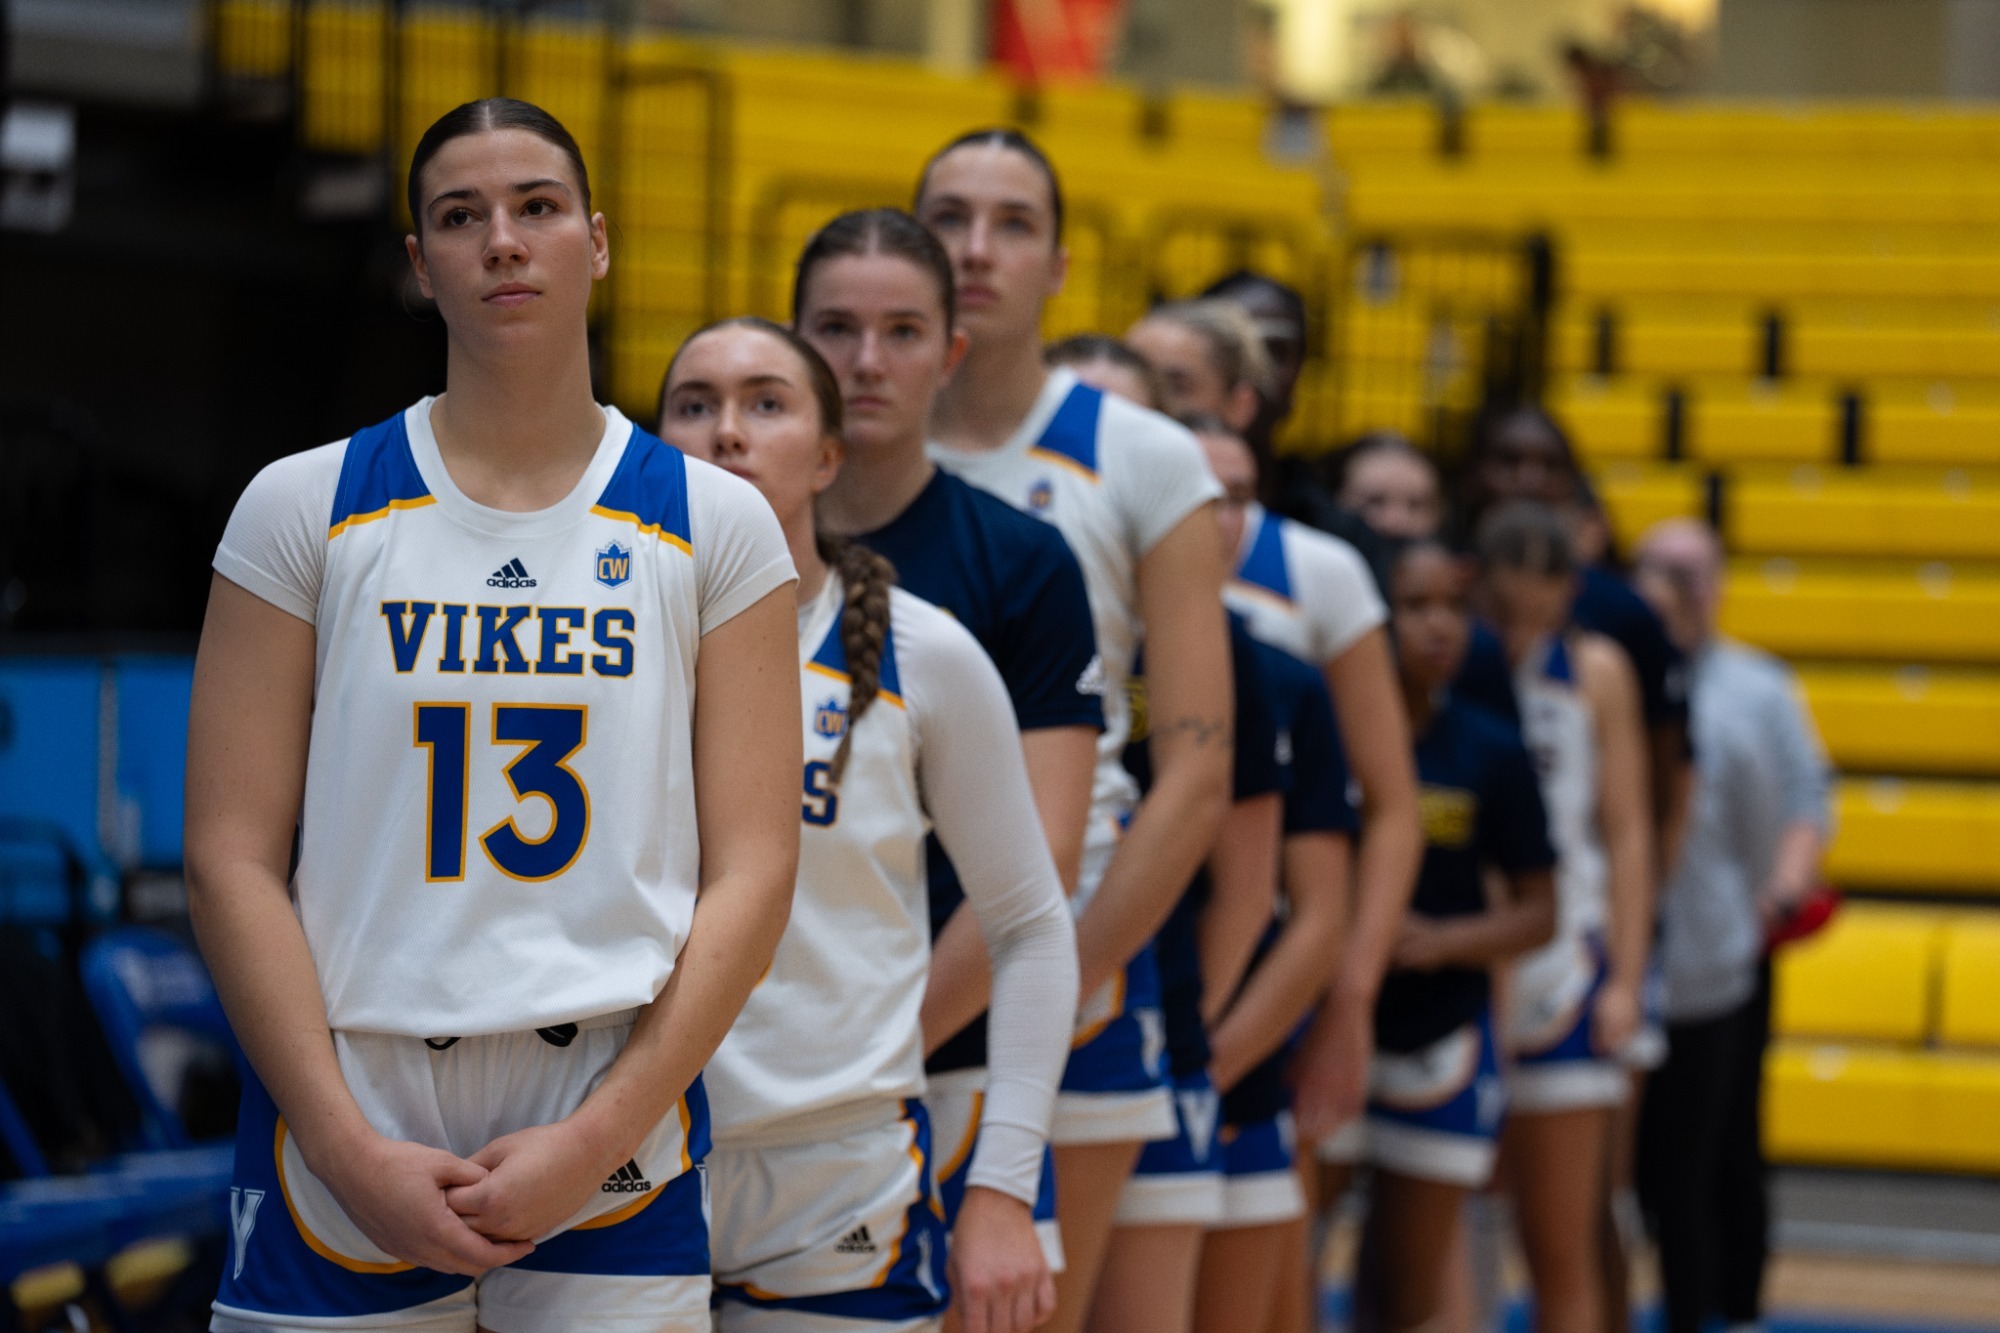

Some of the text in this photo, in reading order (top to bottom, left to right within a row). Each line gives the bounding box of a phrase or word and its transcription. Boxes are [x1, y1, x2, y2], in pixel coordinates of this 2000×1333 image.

[598, 557, 629, 580] CW
[486, 576, 538, 589] adidas
[380, 600, 635, 679] VIKES
[413, 701, 591, 883] 13
[601, 1180, 652, 1193] adidas
